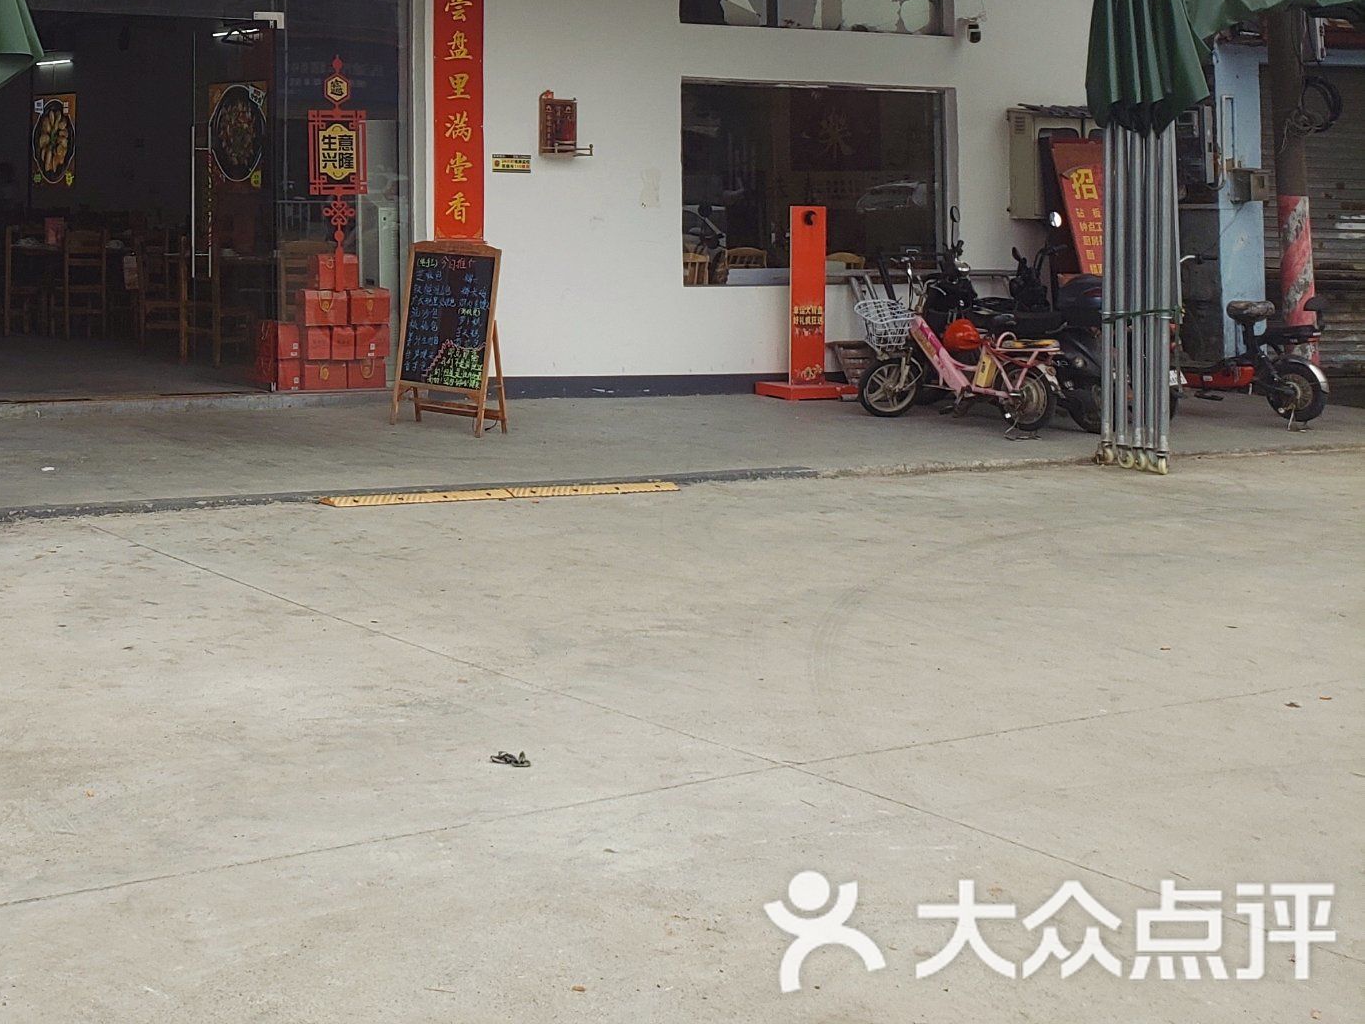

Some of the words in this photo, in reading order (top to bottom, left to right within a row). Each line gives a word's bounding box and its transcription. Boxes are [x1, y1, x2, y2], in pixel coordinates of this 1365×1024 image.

[321, 134, 354, 152] 生意
[321, 152, 355, 169] 兴隆
[1070, 168, 1098, 199] 招
